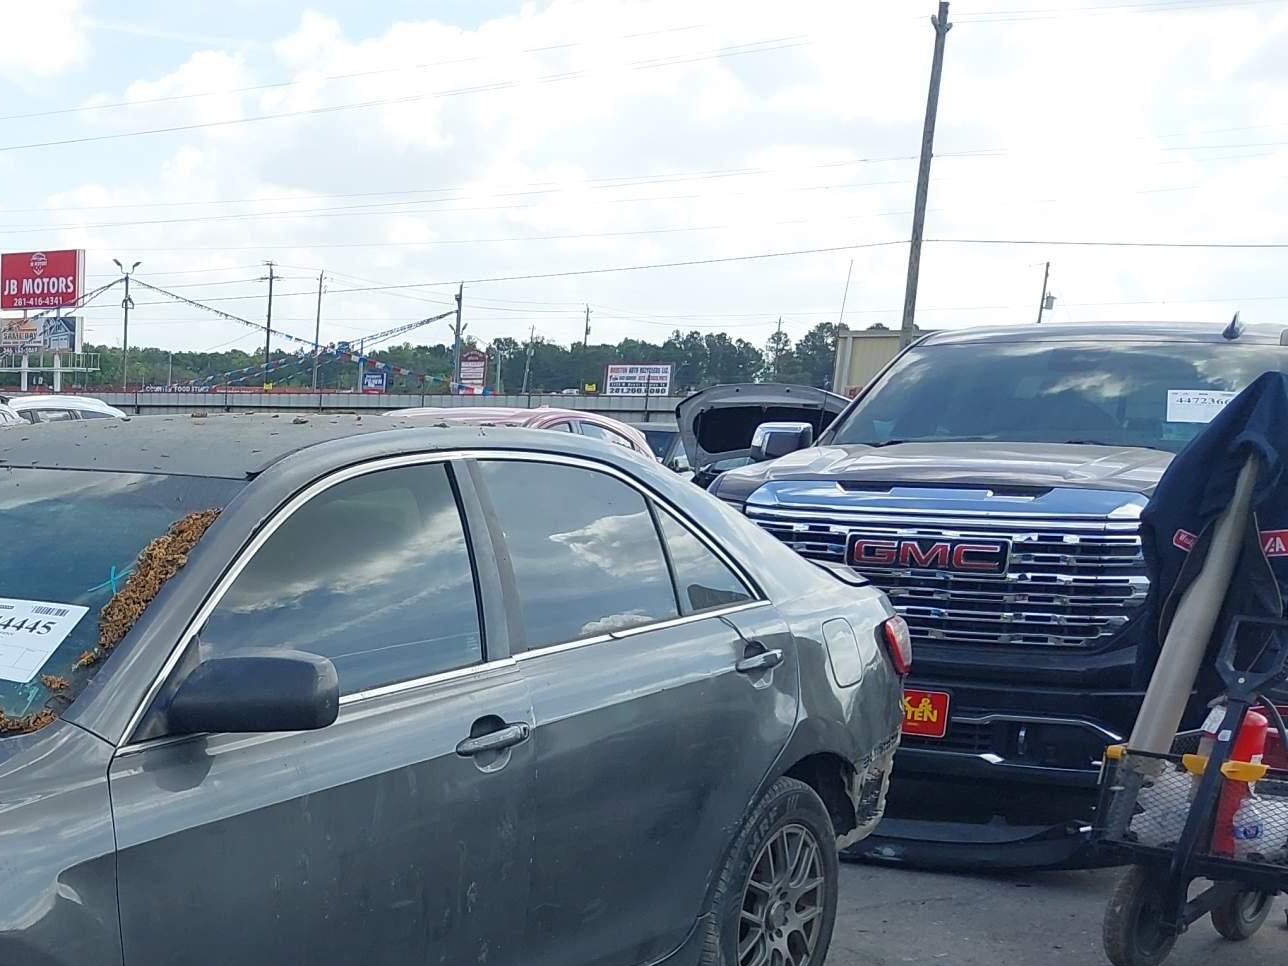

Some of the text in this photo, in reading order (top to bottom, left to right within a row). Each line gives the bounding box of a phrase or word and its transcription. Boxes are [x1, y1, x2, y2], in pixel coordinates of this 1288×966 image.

[3, 276, 74, 295] JB MOTORS
[13, 296, 63, 306] 281-416-4341
[854, 539, 1001, 569] GMC
